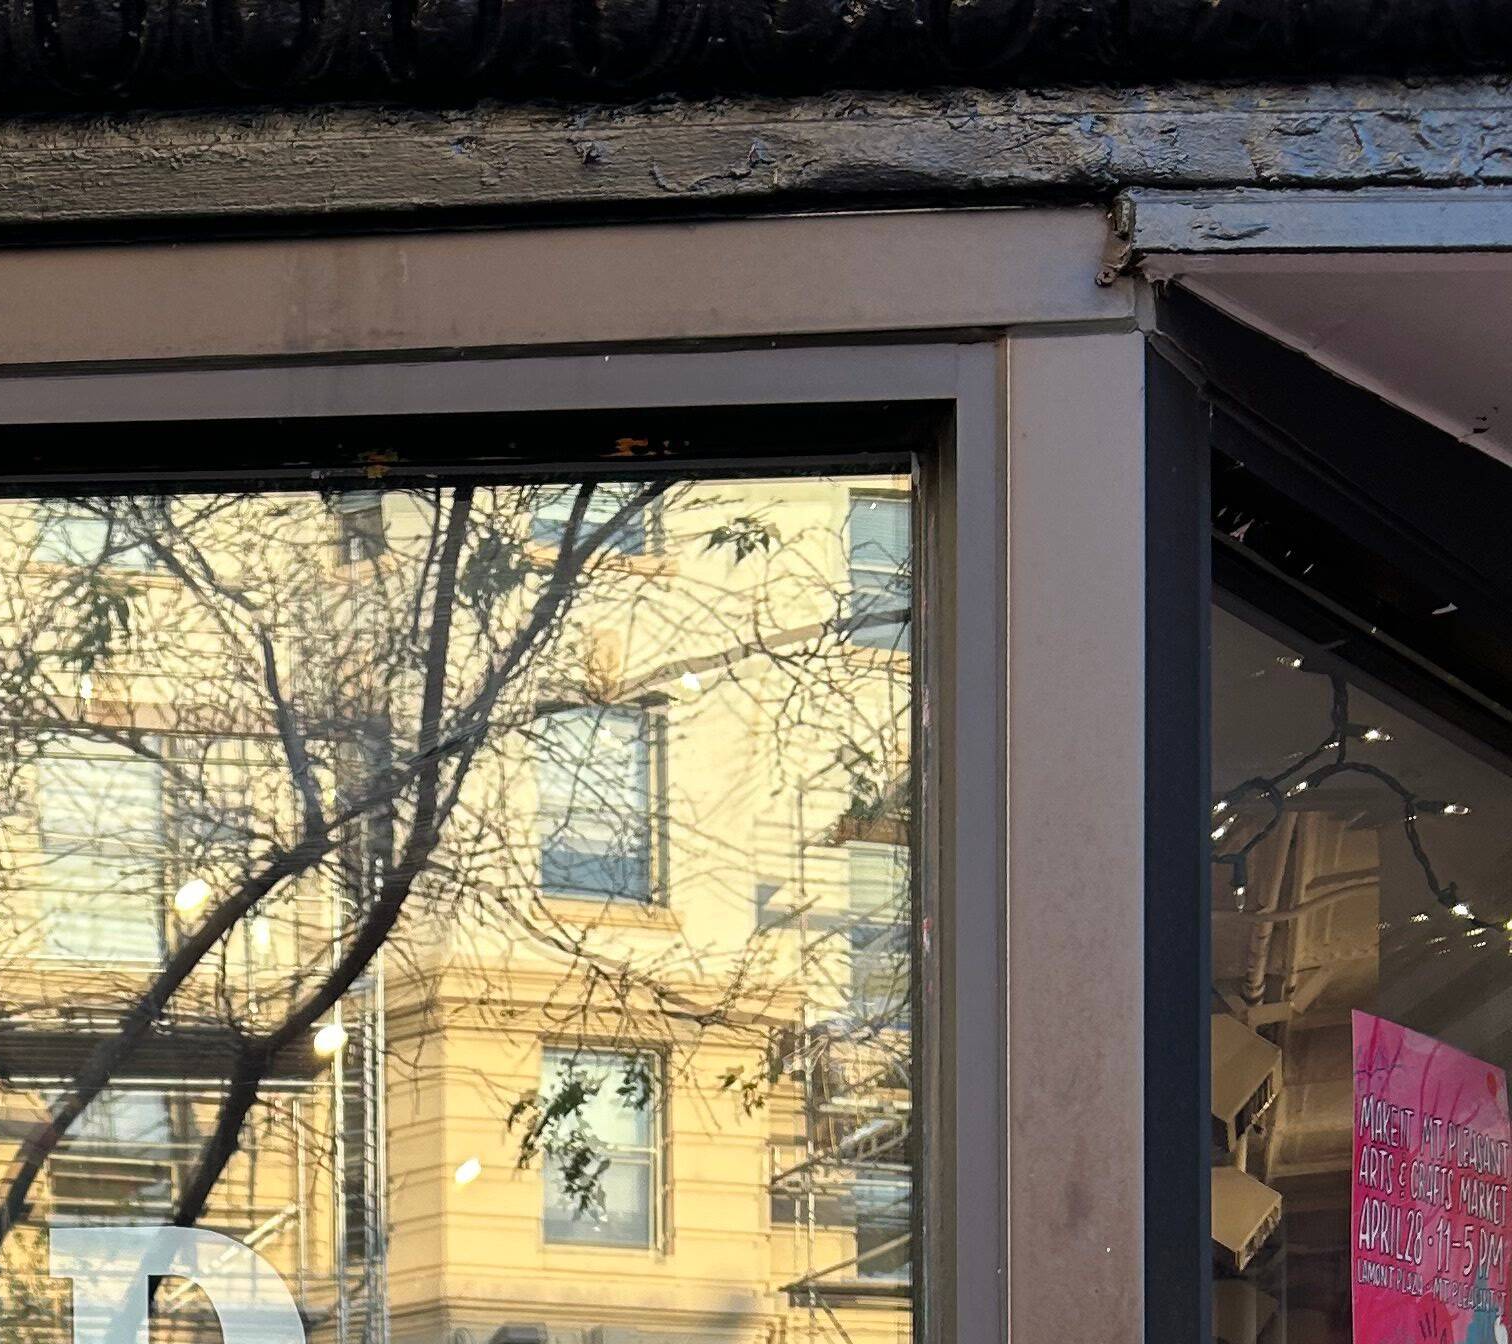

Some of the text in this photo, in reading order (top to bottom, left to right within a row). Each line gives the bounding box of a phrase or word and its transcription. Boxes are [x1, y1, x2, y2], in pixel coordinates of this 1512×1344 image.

[1359, 1092, 1398, 1146] MAKE
[1447, 1122, 1509, 1178] PLEASANT
[1358, 1146, 1395, 1195] ARTS
[1410, 1160, 1455, 1211] CRAFTS
[1459, 1176, 1508, 1227] MARKET
[1357, 1257, 1395, 1288] LAMONT
[1395, 1267, 1423, 1297] PLAZA
[1359, 1197, 1403, 1259] APRIL
[1405, 1210, 1423, 1265] 28
[1478, 1227, 1504, 1284] PM
